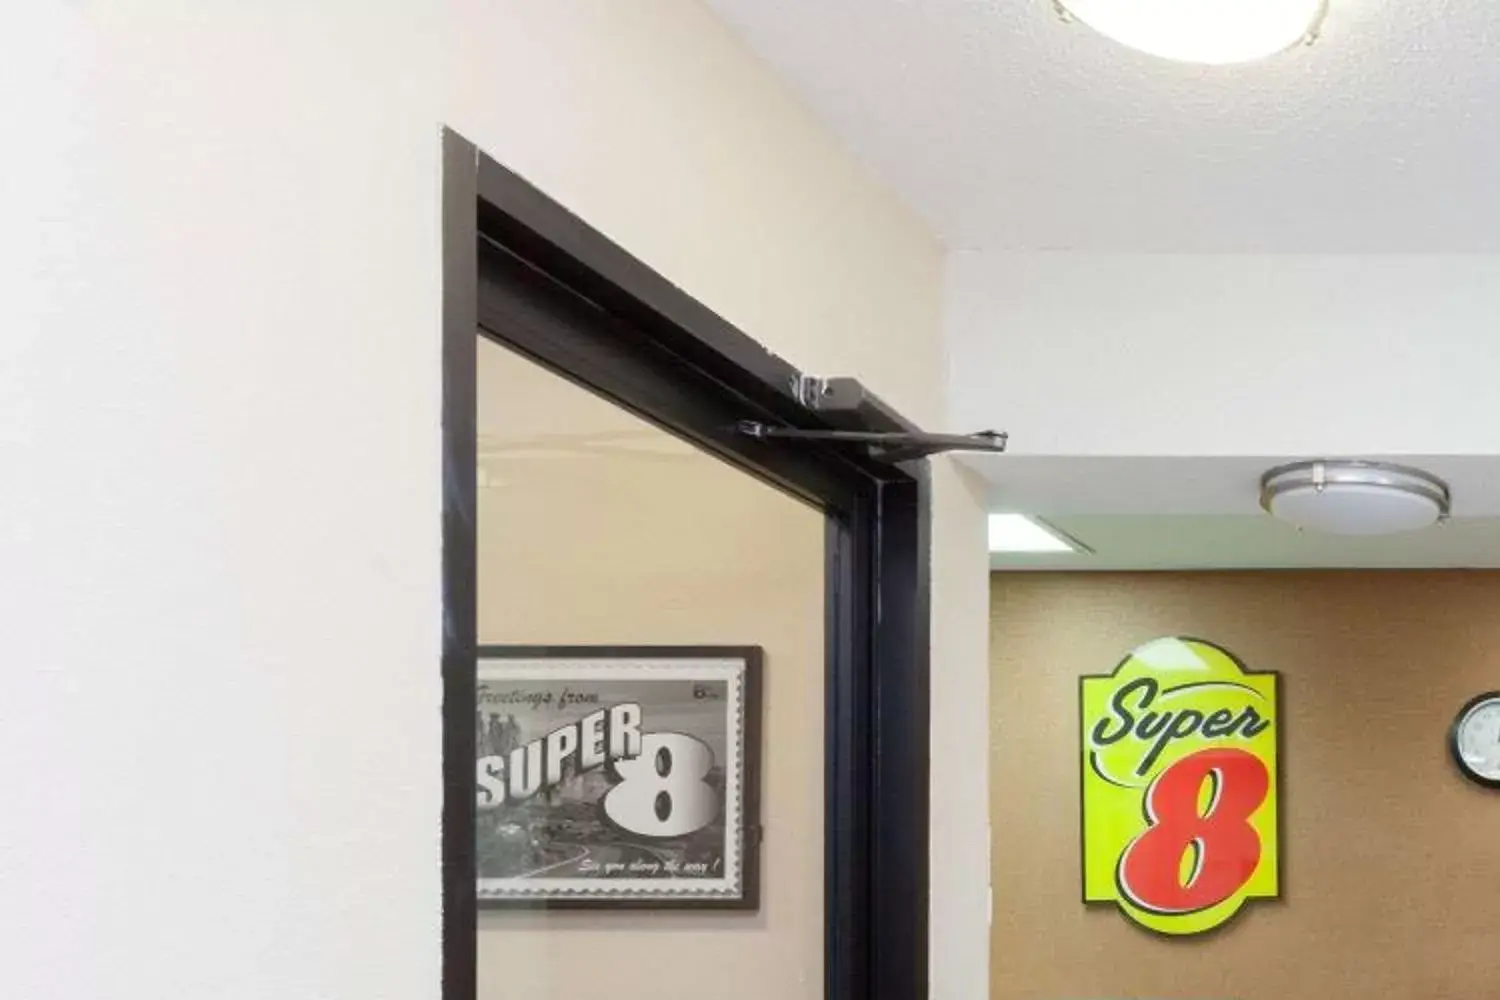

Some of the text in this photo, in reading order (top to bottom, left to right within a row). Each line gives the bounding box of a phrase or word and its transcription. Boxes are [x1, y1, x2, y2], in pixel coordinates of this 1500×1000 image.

[557, 686, 599, 710] from
[1092, 677, 1269, 777] Super
[476, 703, 642, 809] SUPER
[604, 732, 720, 837] 8
[1114, 746, 1269, 916] 8
